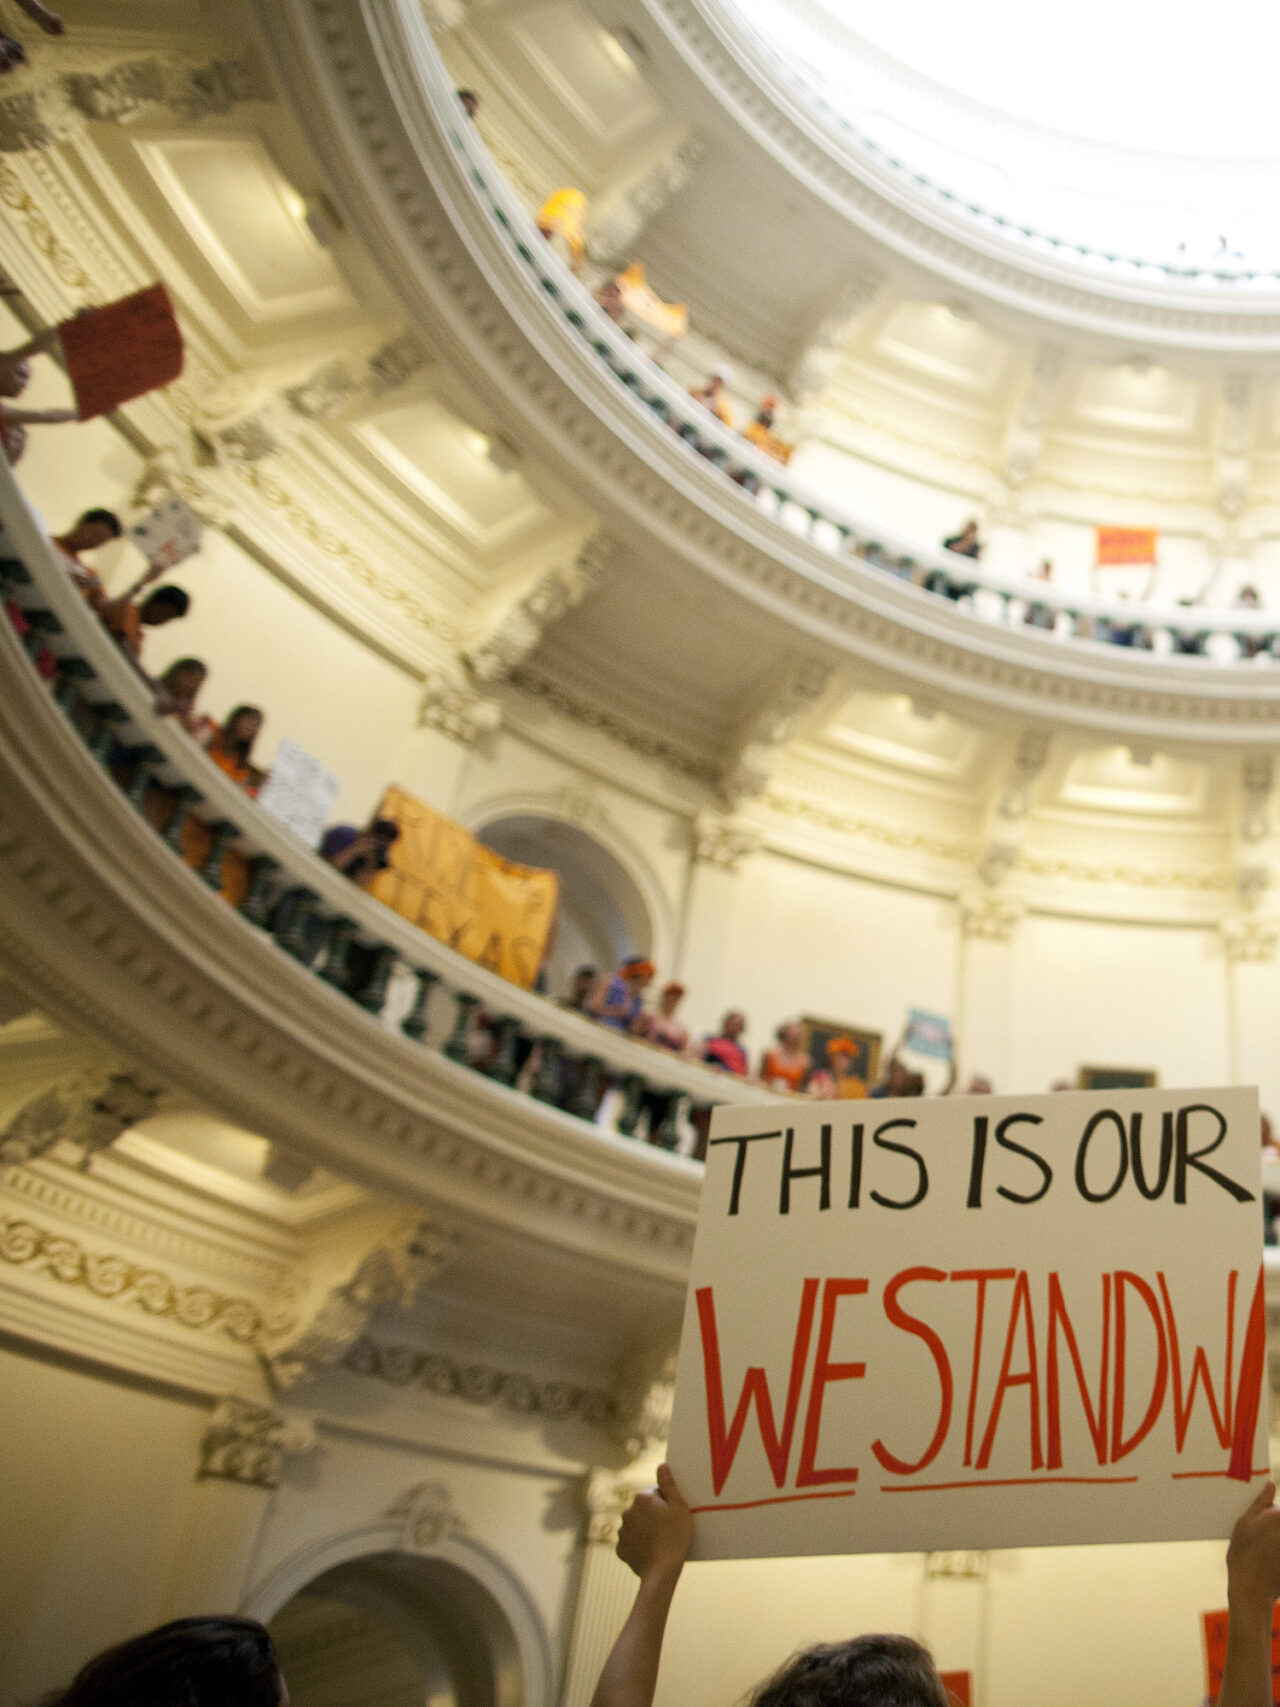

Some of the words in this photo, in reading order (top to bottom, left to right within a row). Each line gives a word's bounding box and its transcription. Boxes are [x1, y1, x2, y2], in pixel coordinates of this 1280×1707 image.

[710, 1117, 929, 1215] THIS
[966, 1112, 1053, 1209] IS
[1074, 1104, 1256, 1205] OUR
[695, 1278, 870, 1497] WE
[871, 1266, 1169, 1475] STAND
